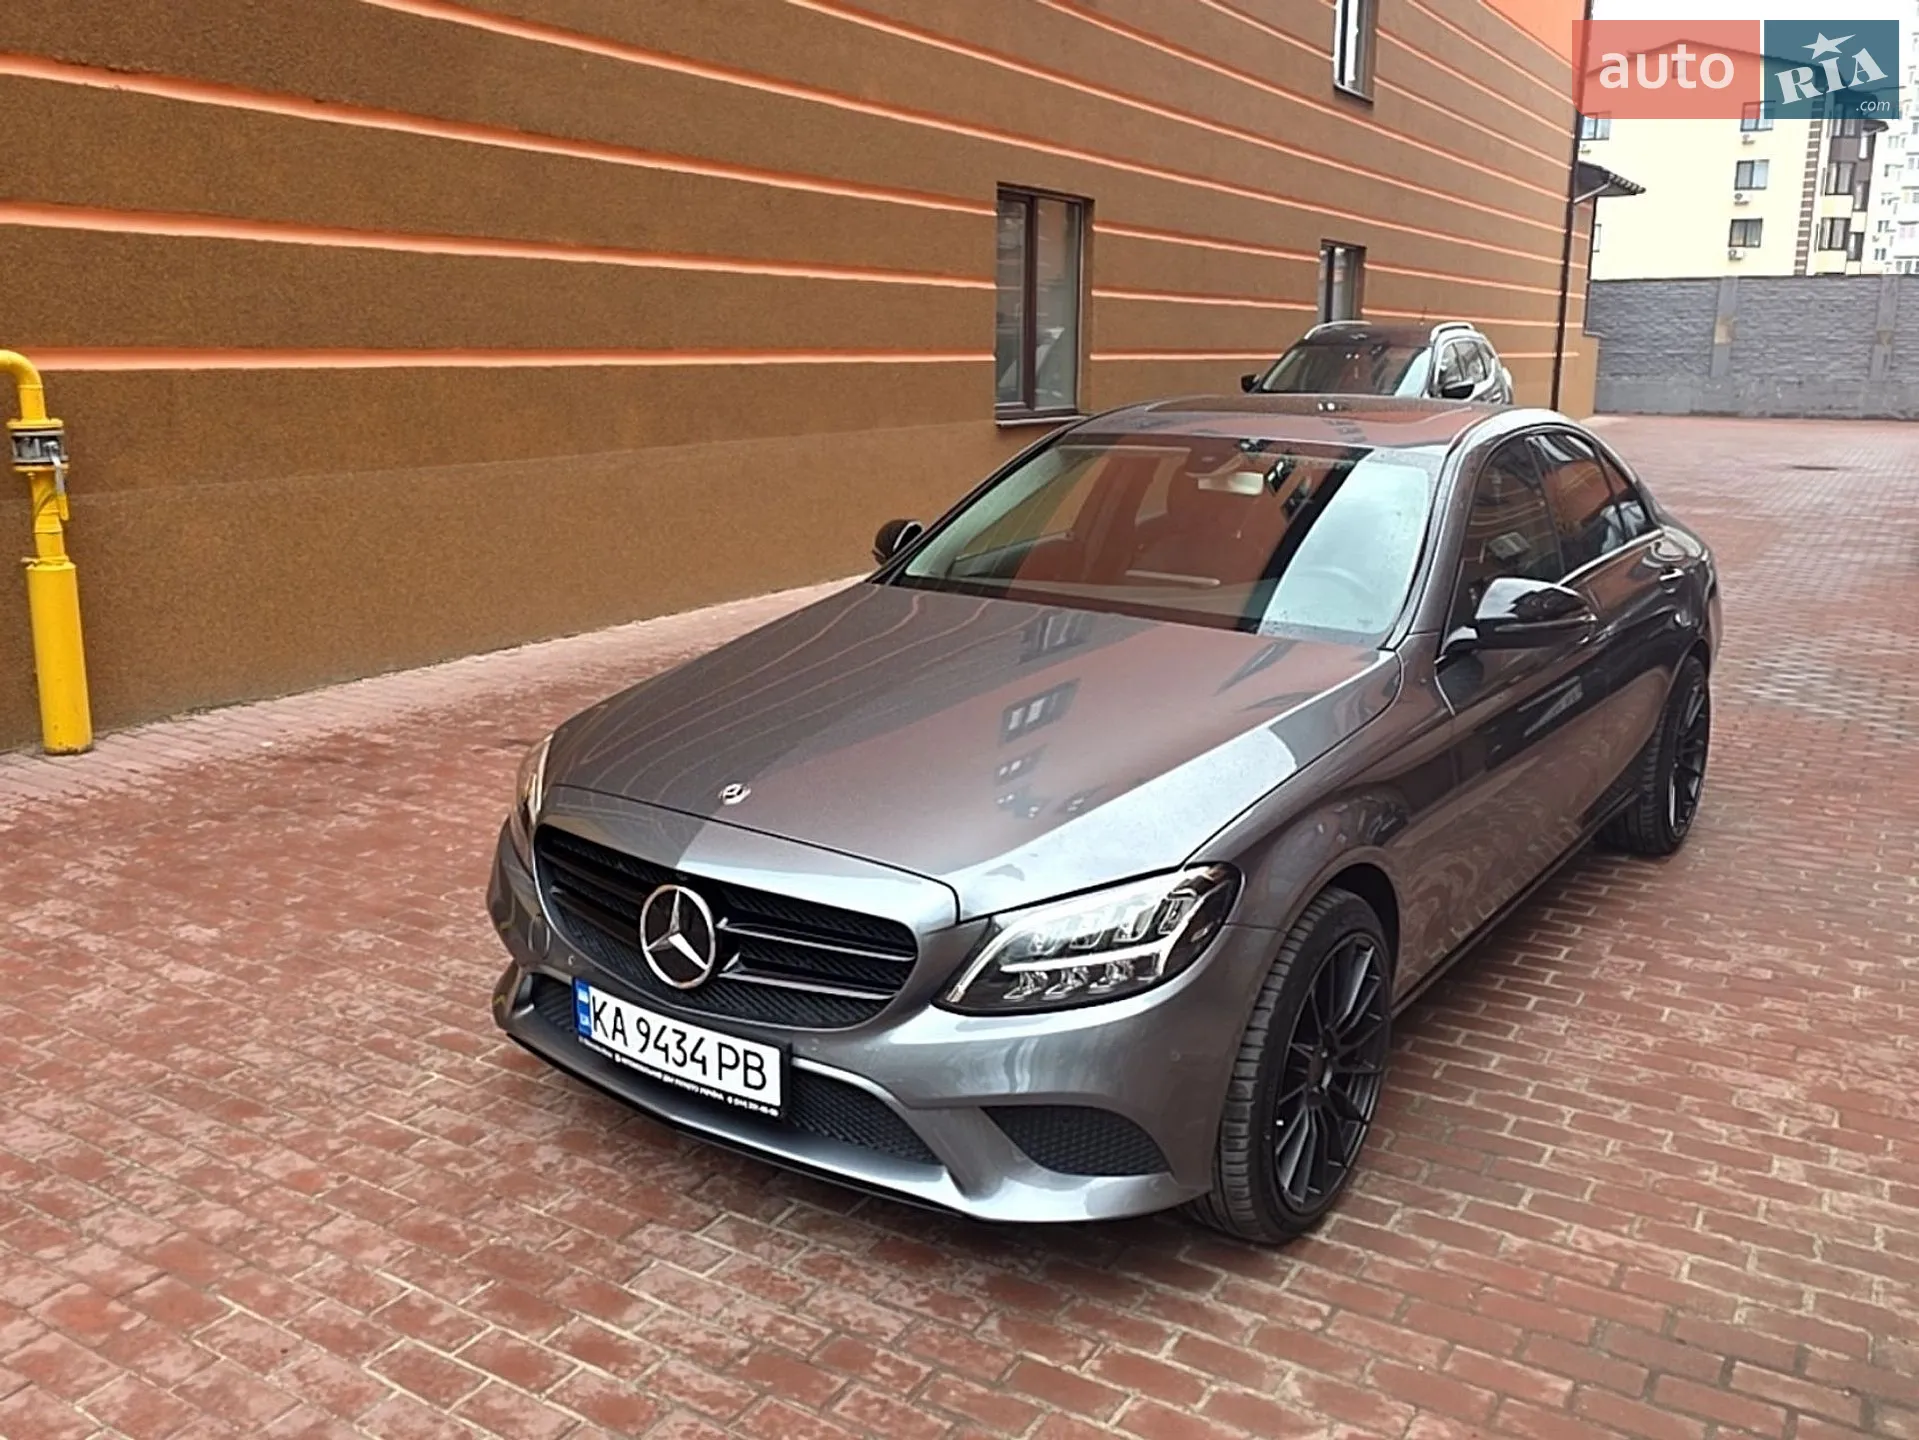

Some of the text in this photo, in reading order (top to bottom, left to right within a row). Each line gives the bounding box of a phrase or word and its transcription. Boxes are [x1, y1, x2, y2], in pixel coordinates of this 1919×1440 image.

[592, 995, 629, 1047] KA
[636, 1017, 708, 1076] 9434
[717, 1042, 768, 1091] PB
